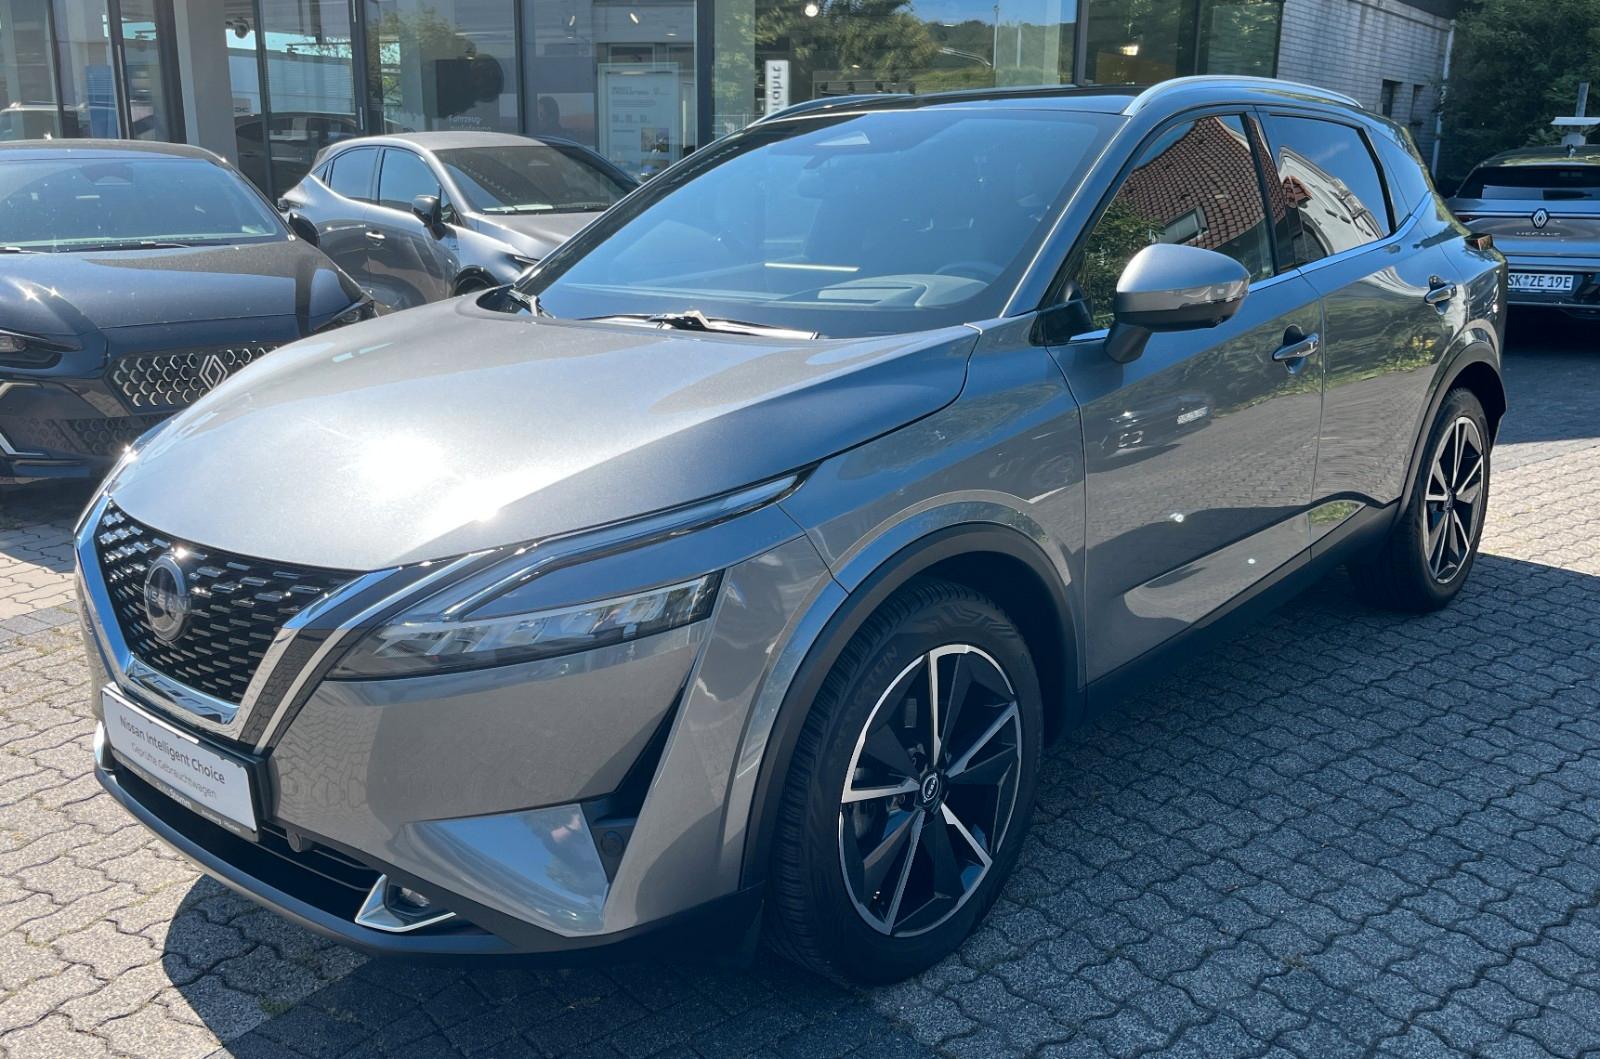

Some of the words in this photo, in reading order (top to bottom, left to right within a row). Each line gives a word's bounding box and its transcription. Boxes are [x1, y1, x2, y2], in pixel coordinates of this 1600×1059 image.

[1529, 275, 1545, 288] ZE
[1547, 276, 1571, 288] 19E
[119, 714, 146, 741] Nissan
[147, 731, 191, 767] Intelligent
[191, 758, 226, 785] Choice
